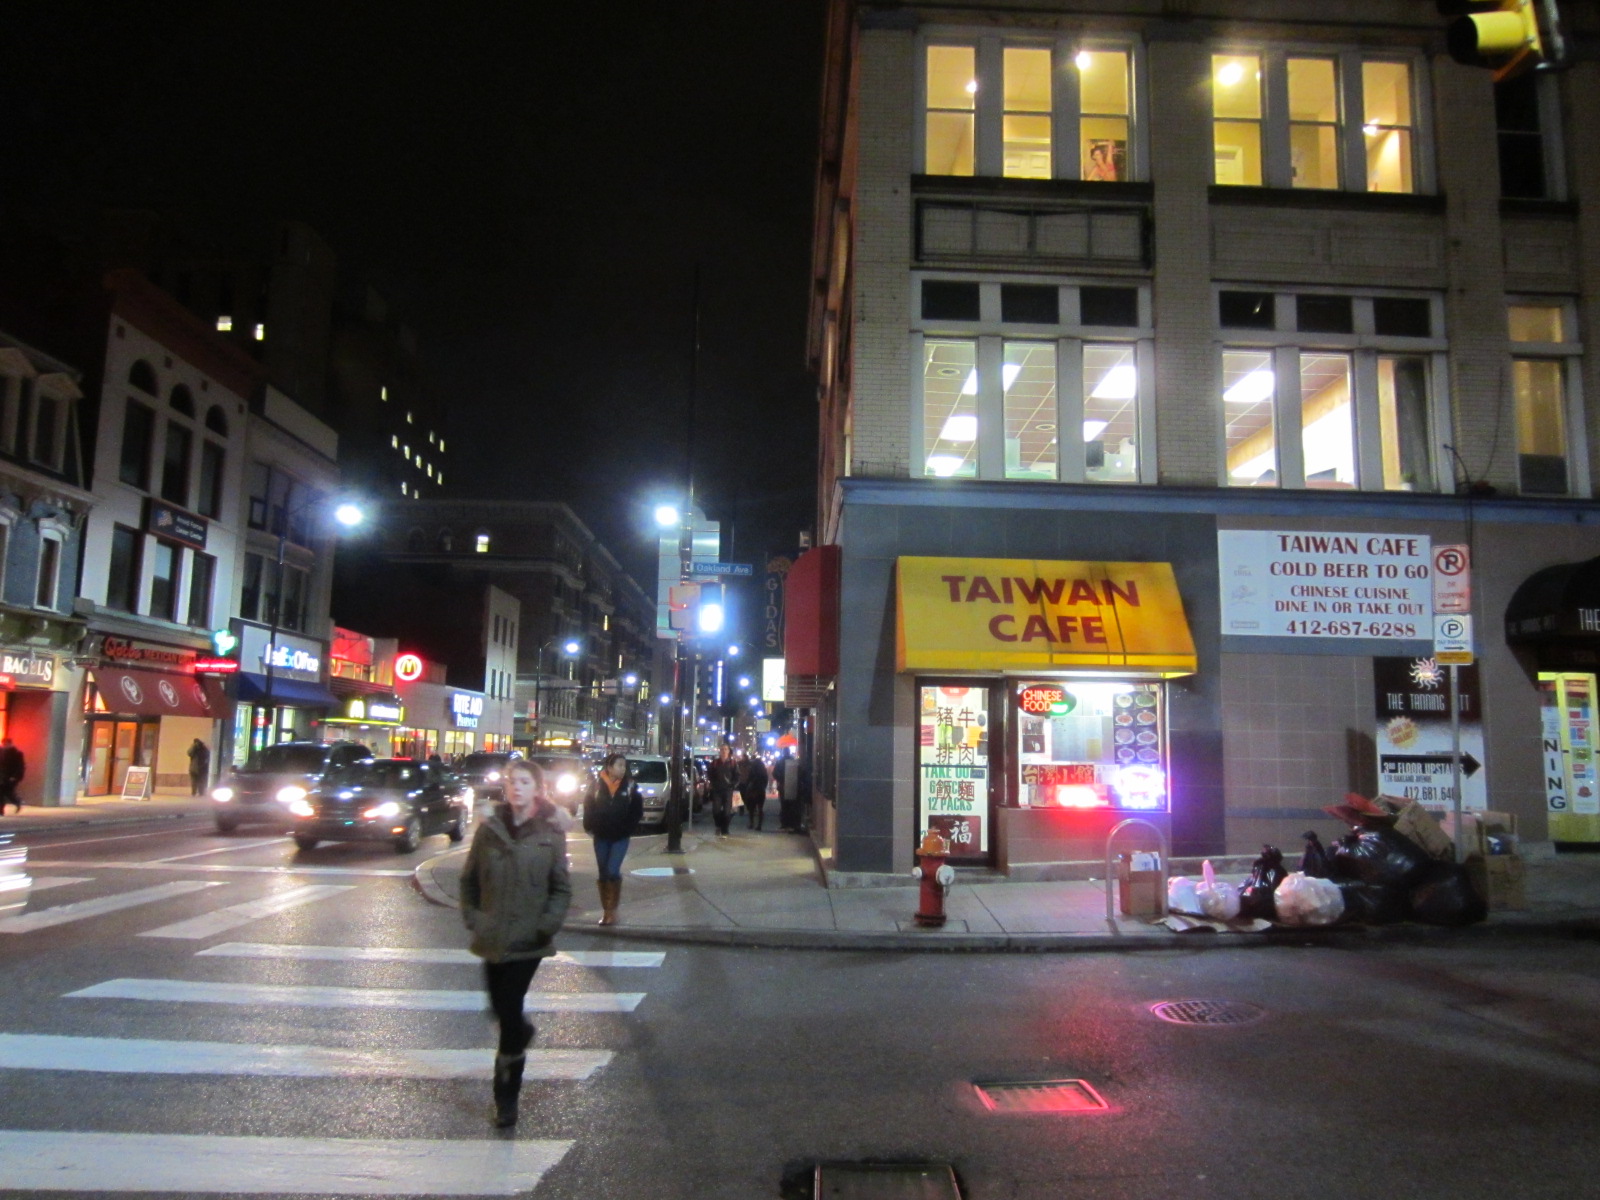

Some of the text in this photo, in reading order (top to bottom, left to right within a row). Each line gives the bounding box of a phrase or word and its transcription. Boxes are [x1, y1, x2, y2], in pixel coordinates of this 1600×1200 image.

[1277, 535, 1420, 557] TAIWAN CAFE
[697, 565, 749, 574] Oakland Ave
[1270, 561, 1317, 577] COLD
[1323, 562, 1369, 578] BEER
[1375, 564, 1398, 579] TO
[1404, 565, 1429, 579] GO
[942, 575, 1141, 607] TAIWAN
[1290, 585, 1410, 600] CHINESE CUISINE
[766, 578, 778, 647] GIDAS
[1275, 600, 1425, 616] DINE IN OR TAKE OUT
[1286, 620, 1416, 637] 412-687-6288
[1578, 608, 1600, 632] THE
[988, 614, 1108, 644] CAFE
[1448, 623, 1458, 635] P
[2, 655, 53, 681] BAGELS
[1023, 689, 1062, 701] CHINESE
[1386, 693, 1404, 710] THE
[453, 693, 471, 715] RITE
[1023, 700, 1052, 711] FOOD
[1397, 762, 1423, 774] FLOOR
[1424, 762, 1464, 775] UPSTAS
[1404, 785, 1462, 801] 412.681.64
[928, 797, 973, 811] 12 PACKS
[949, 820, 972, 844] 福
